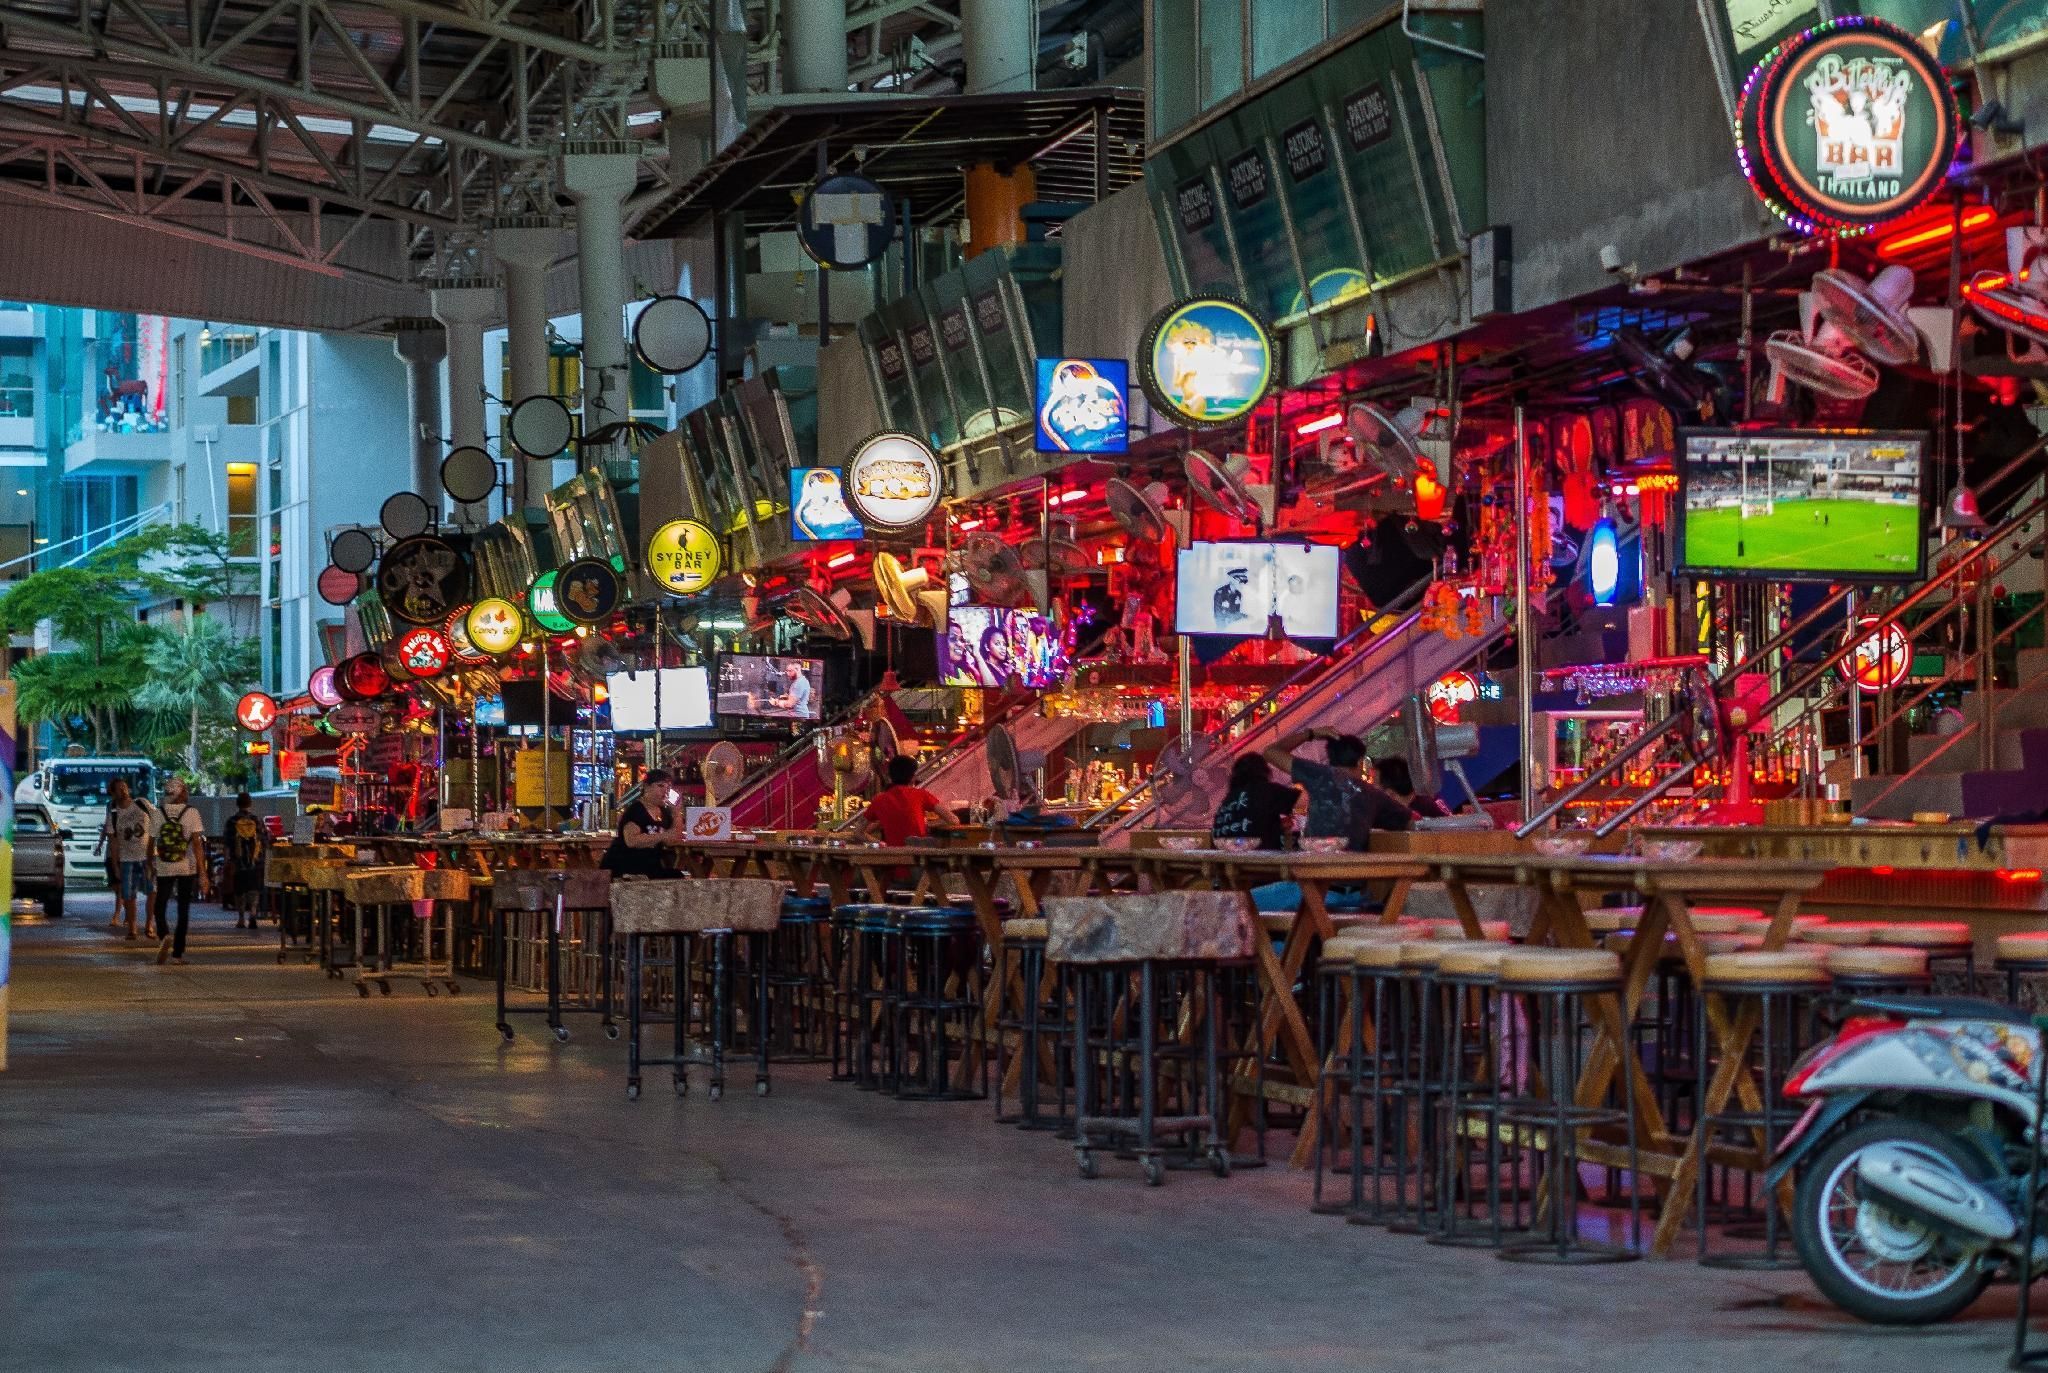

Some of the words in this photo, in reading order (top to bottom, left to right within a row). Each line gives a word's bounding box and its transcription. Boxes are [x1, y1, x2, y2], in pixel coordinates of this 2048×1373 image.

[1816, 176, 1900, 199] THAILAND
[656, 551, 712, 562] SYDNEY
[674, 560, 702, 570] BAR
